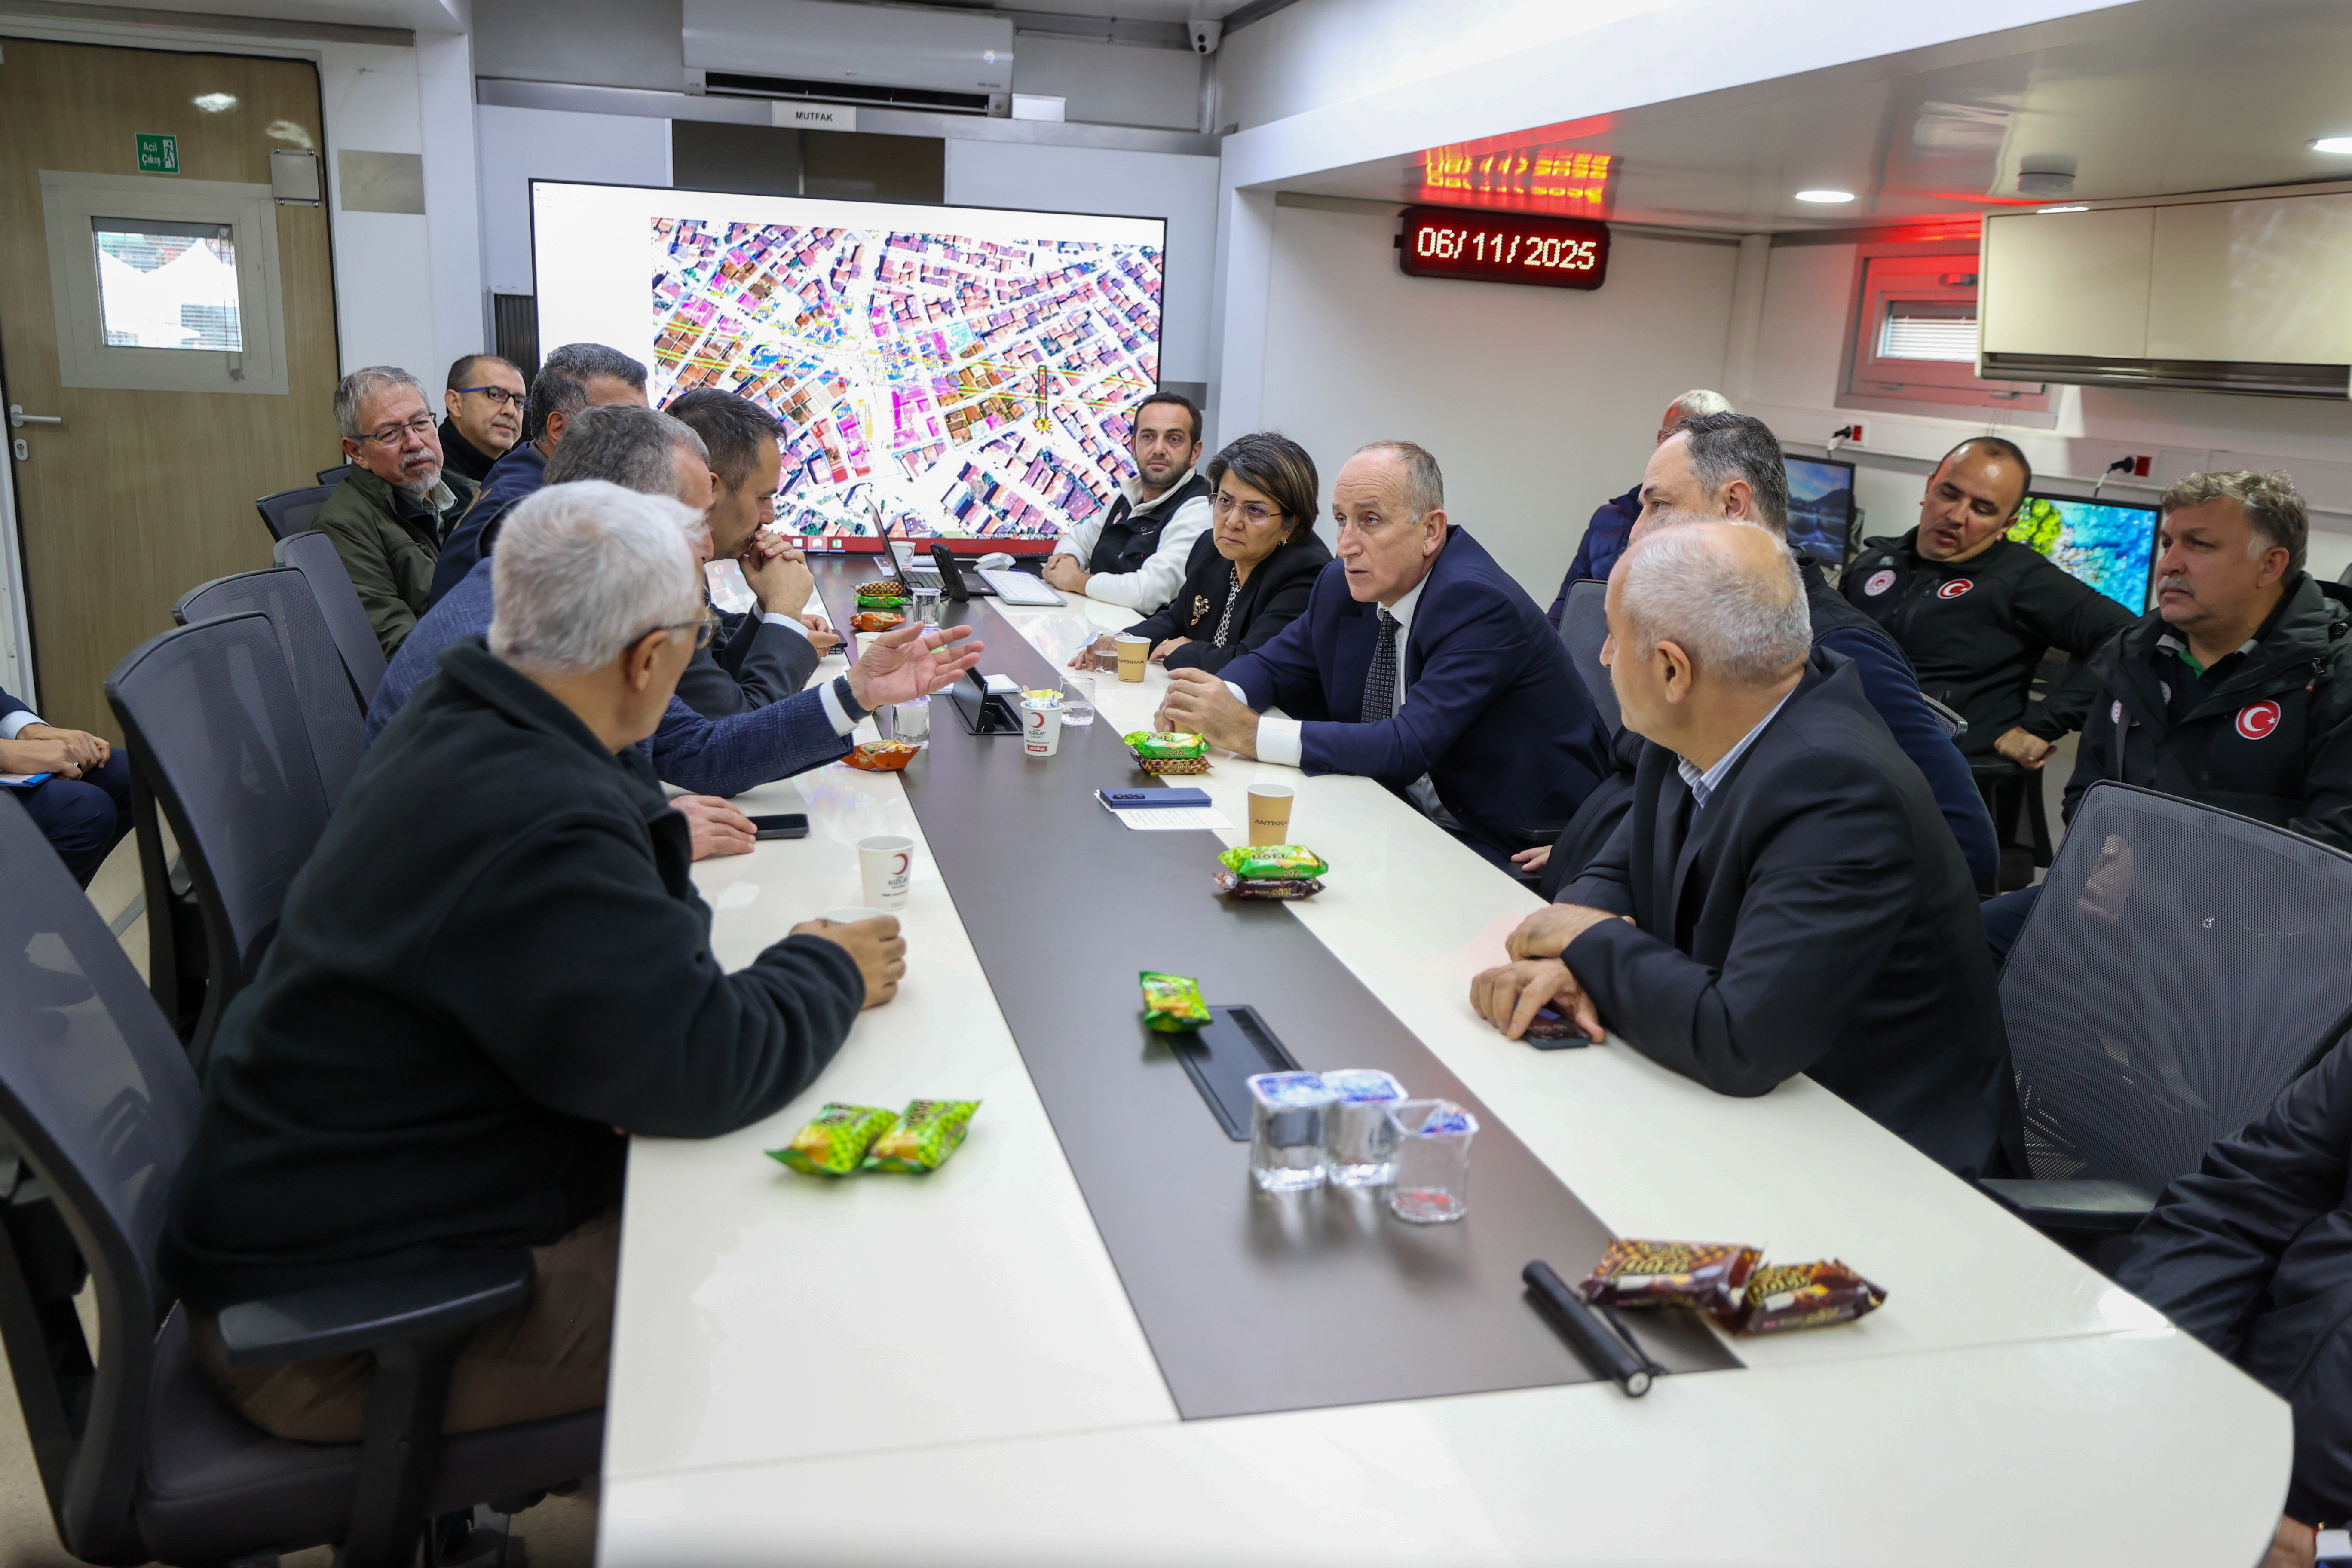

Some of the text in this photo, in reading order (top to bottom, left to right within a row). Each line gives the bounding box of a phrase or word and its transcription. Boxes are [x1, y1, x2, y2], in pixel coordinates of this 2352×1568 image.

[796, 111, 833, 122] MUTFAK
[143, 141, 158, 152] Acil
[142, 153, 161, 167] Çıkış
[1417, 227, 1597, 270] 06/11/2025
